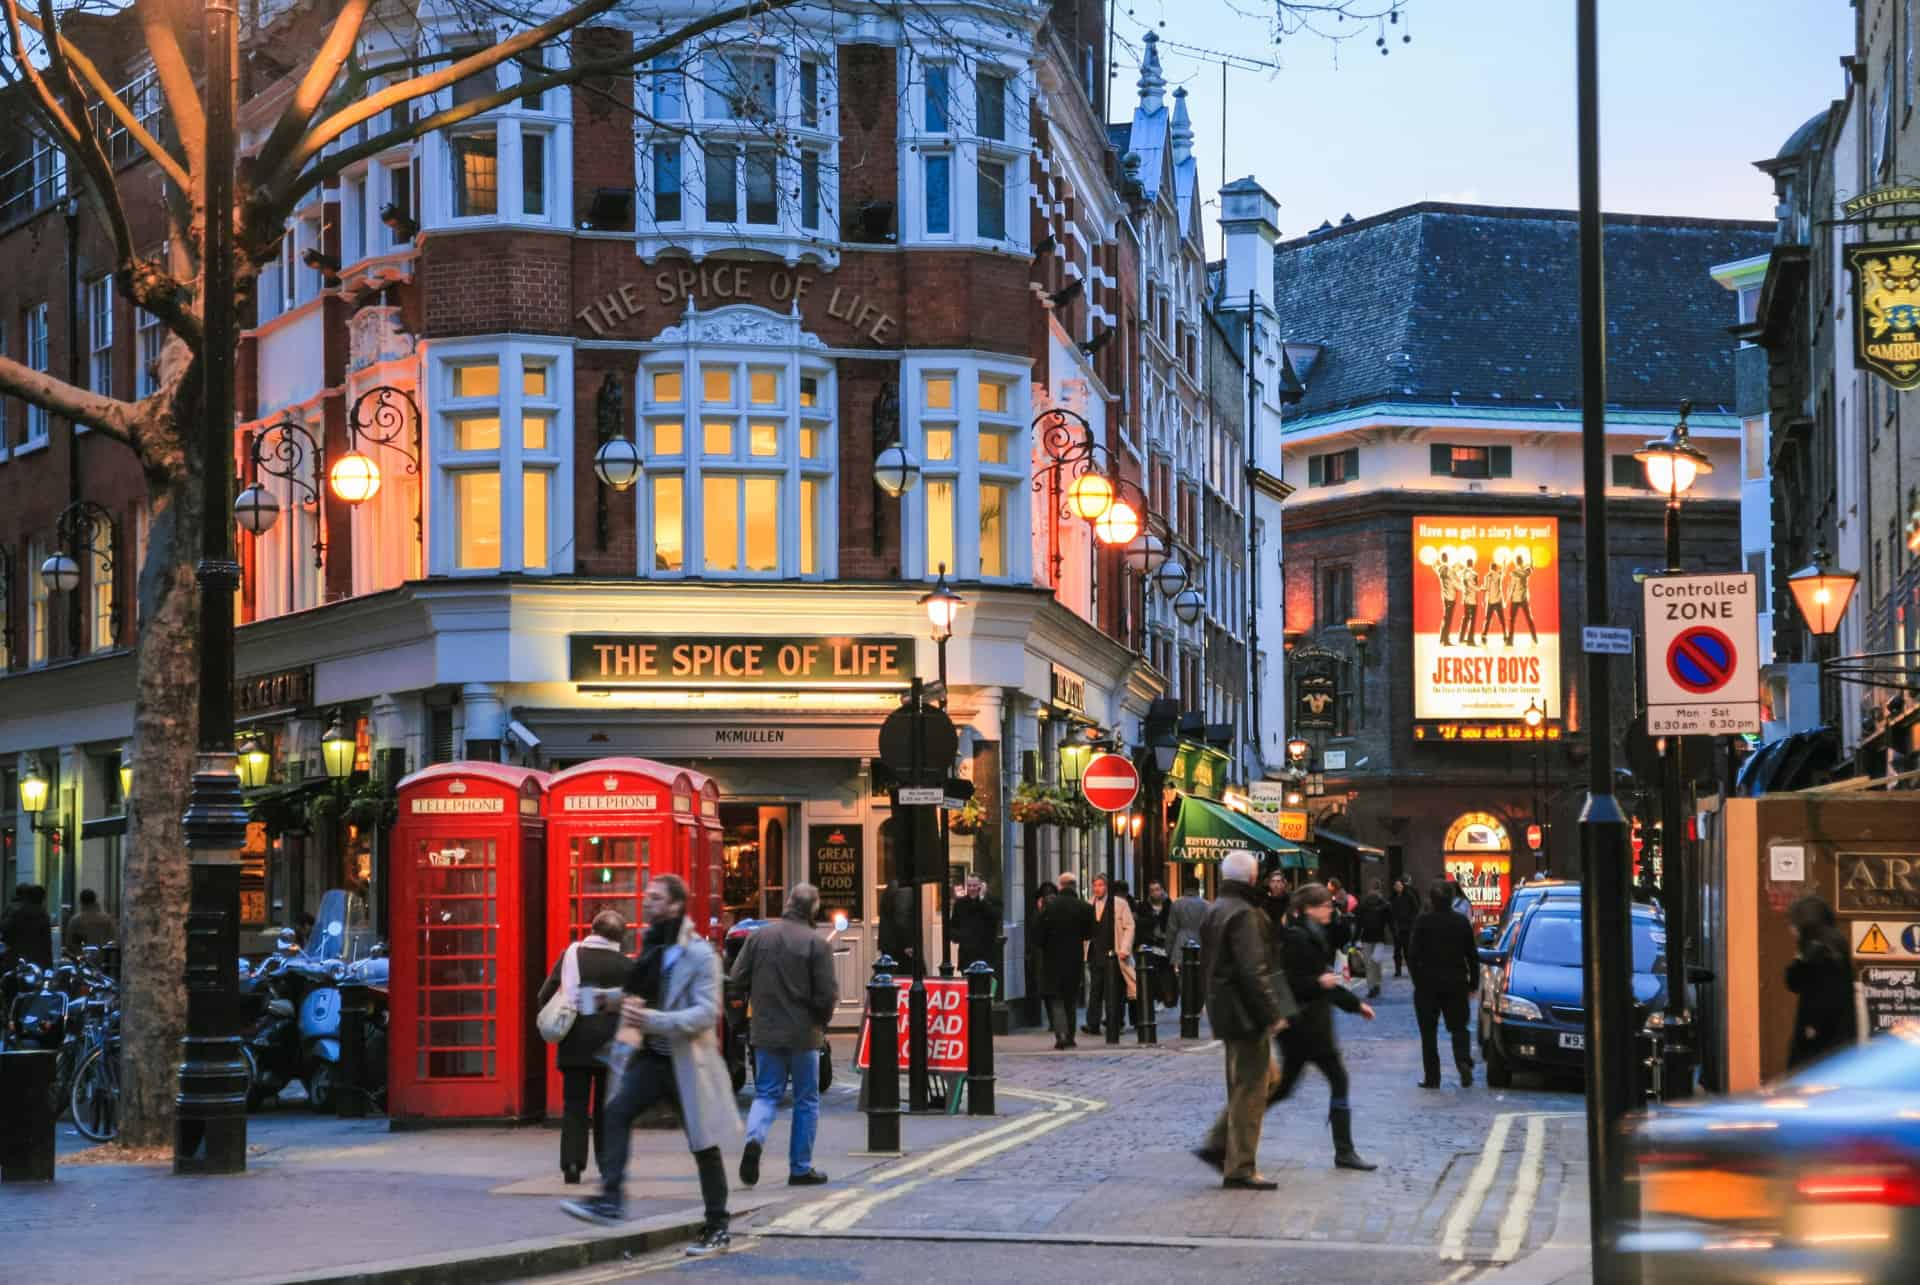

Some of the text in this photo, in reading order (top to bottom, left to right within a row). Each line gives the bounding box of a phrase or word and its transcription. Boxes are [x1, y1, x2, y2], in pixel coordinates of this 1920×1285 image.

[576, 266, 897, 345] THE SPICE OF LIFE
[1419, 524, 1442, 537] Have
[1460, 525, 1476, 540] got
[1488, 526, 1511, 540] story
[1514, 525, 1527, 537] for
[1652, 581, 1748, 597] Controlled
[1666, 601, 1733, 620] ZONE
[593, 644, 899, 677] THE SPICE OF LIFE
[1432, 656, 1540, 684] JERSEY BOYS
[1676, 708, 1729, 718] Mon Sat
[417, 799, 498, 812] TELEPHONE
[570, 797, 652, 809] TELEPHONE
[1184, 837, 1248, 849] RISTORANTE
[817, 848, 856, 860] GREAT
[818, 862, 856, 873] FRESH
[821, 877, 852, 888] FOOD
[897, 989, 960, 1010] RAD
